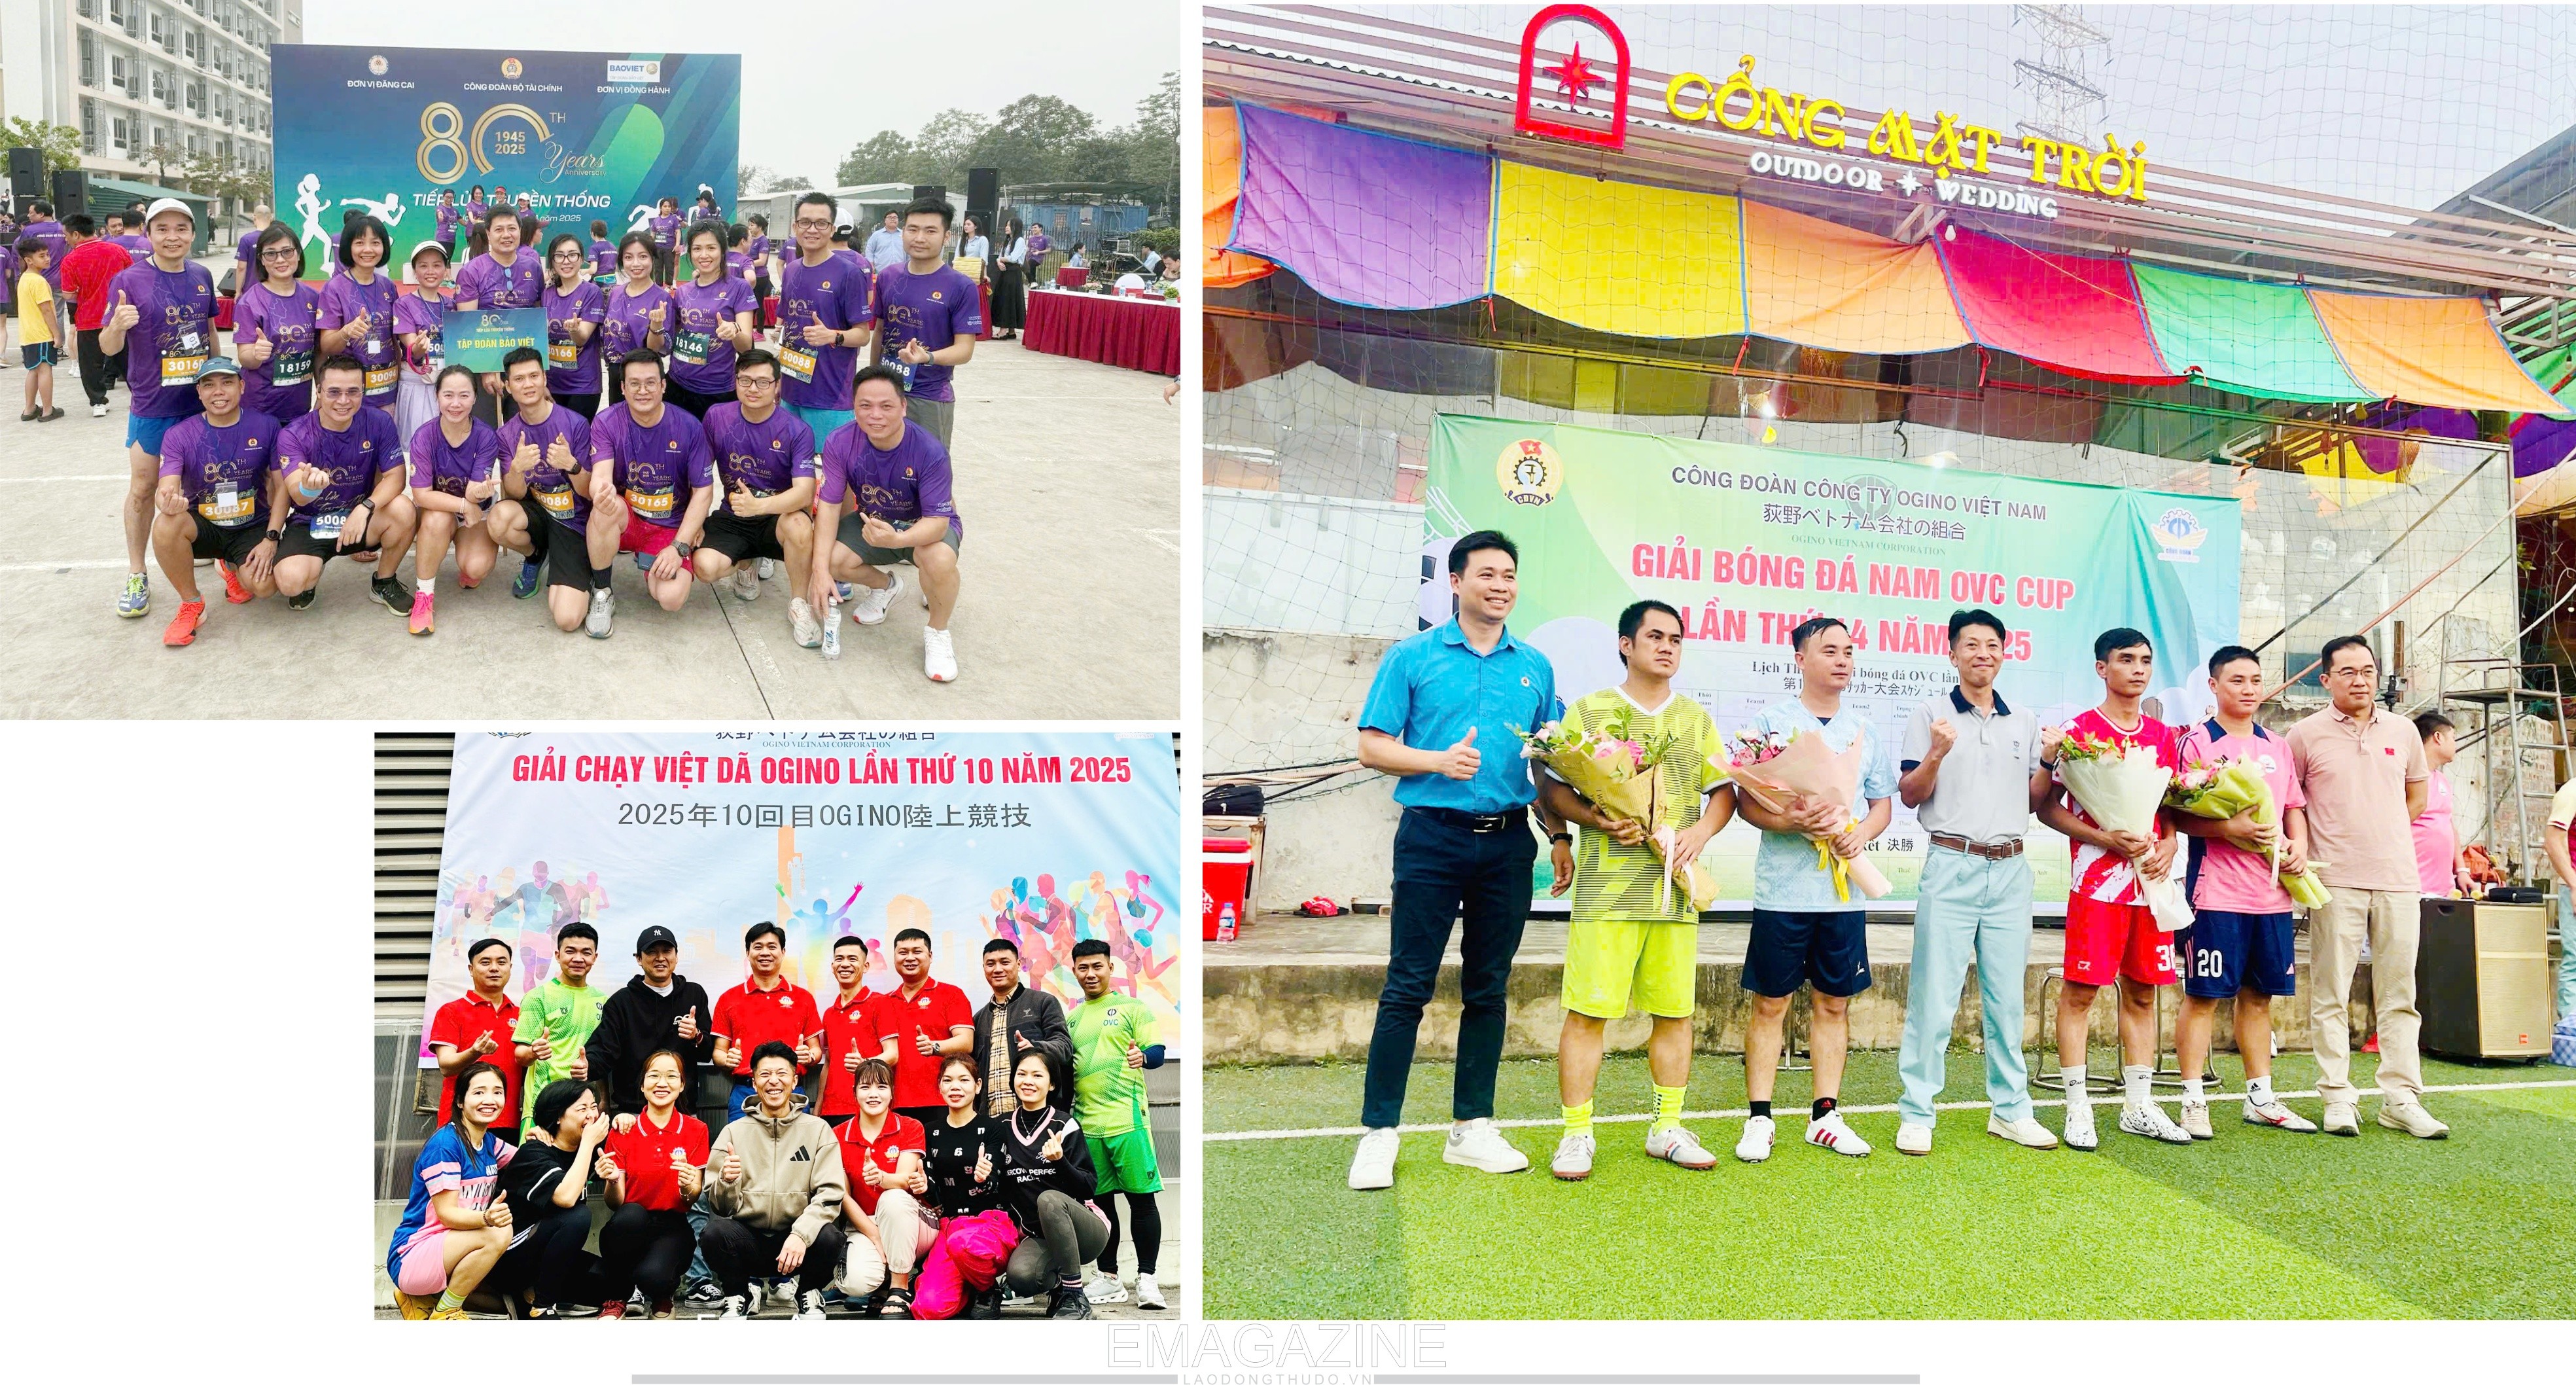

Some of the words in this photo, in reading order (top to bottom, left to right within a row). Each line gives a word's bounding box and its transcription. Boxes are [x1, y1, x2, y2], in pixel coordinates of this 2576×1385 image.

[347, 80, 366, 88] ĐƠN
[367, 81, 376, 89] VỊ
[376, 79, 400, 88] ĐĂNG
[463, 82, 487, 92] CÔNG
[488, 82, 512, 92] ĐOÀN
[512, 82, 524, 93] BỘ
[524, 82, 537, 92] TÀI
[537, 82, 563, 92] CHÍNH
[597, 85, 614, 94] ĐƠN
[615, 86, 623, 95] VỊ
[624, 84, 647, 94] ĐỒNG
[648, 86, 671, 94] HÀNH
[549, 112, 567, 124] TH
[495, 130, 525, 143] 1945
[1665, 54, 1846, 150] CỔNG
[1867, 107, 2002, 182] MẶT
[2020, 131, 2149, 202] TRỜI
[495, 143, 526, 155] 2025
[539, 141, 608, 184] Years
[1749, 150, 1884, 192] OUTDOOR
[564, 169, 607, 177] Anniversary
[555, 189, 611, 207] THỐNG
[457, 338, 472, 351] TẬP
[474, 338, 497, 348] ĐOÀN
[499, 336, 516, 348] BẢO
[676, 336, 703, 353] 18146
[279, 359, 311, 374] 18159
[783, 351, 811, 369] 30088
[370, 370, 397, 384] 30094
[630, 494, 668, 507] 30165
[1671, 464, 1733, 488] CÔNG
[1740, 472, 1797, 495] ĐOÀN
[1803, 478, 1861, 502] CÔNG
[1867, 486, 1891, 504] TY
[1897, 490, 1958, 512] OGINO
[1963, 495, 2003, 518] VIỆT
[2007, 501, 2047, 520] NAM
[316, 514, 347, 526] 5008
[1763, 502, 1967, 541] 荻野ベトナム会社の組合
[1791, 533, 1826, 545] OGINO
[1829, 537, 1875, 550] VIETNAM
[1876, 541, 1947, 556] CORPORATION
[1631, 535, 1701, 582] GIẢI
[1713, 545, 1805, 590] BÓNG
[1815, 553, 1861, 594] ĐÁ
[1868, 563, 1945, 600] NAM
[1950, 569, 2006, 606] OVC
[2016, 576, 2076, 611] CUP
[1683, 596, 1747, 643] LẦN
[1878, 615, 1949, 657] NĂM
[2003, 628, 2033, 662] 25
[1752, 661, 1780, 677] Lịch
[1784, 663, 1803, 675] Th
[1860, 668, 1888, 682] bóng
[1892, 668, 1906, 681] đá
[1909, 670, 1939, 683] OVC
[1942, 670, 1960, 684] lần
[512, 746, 567, 782] GIẢI
[575, 754, 645, 789] CHẠY
[653, 750, 709, 789] VIỆT
[716, 751, 752, 784] DÃ
[760, 757, 840, 785] OGINO
[849, 748, 898, 785] LẦN
[906, 748, 957, 785] THỨ
[962, 757, 995, 785] 10
[1001, 751, 1063, 784] NĂM
[1070, 756, 1132, 784] 2025
[618, 802, 1032, 829] 2025年10回目OGINO陸上競技
[1887, 837, 1914, 852] 決勝
[2197, 948, 2223, 978] 20
[1103, 1018, 1120, 1027] OVC
